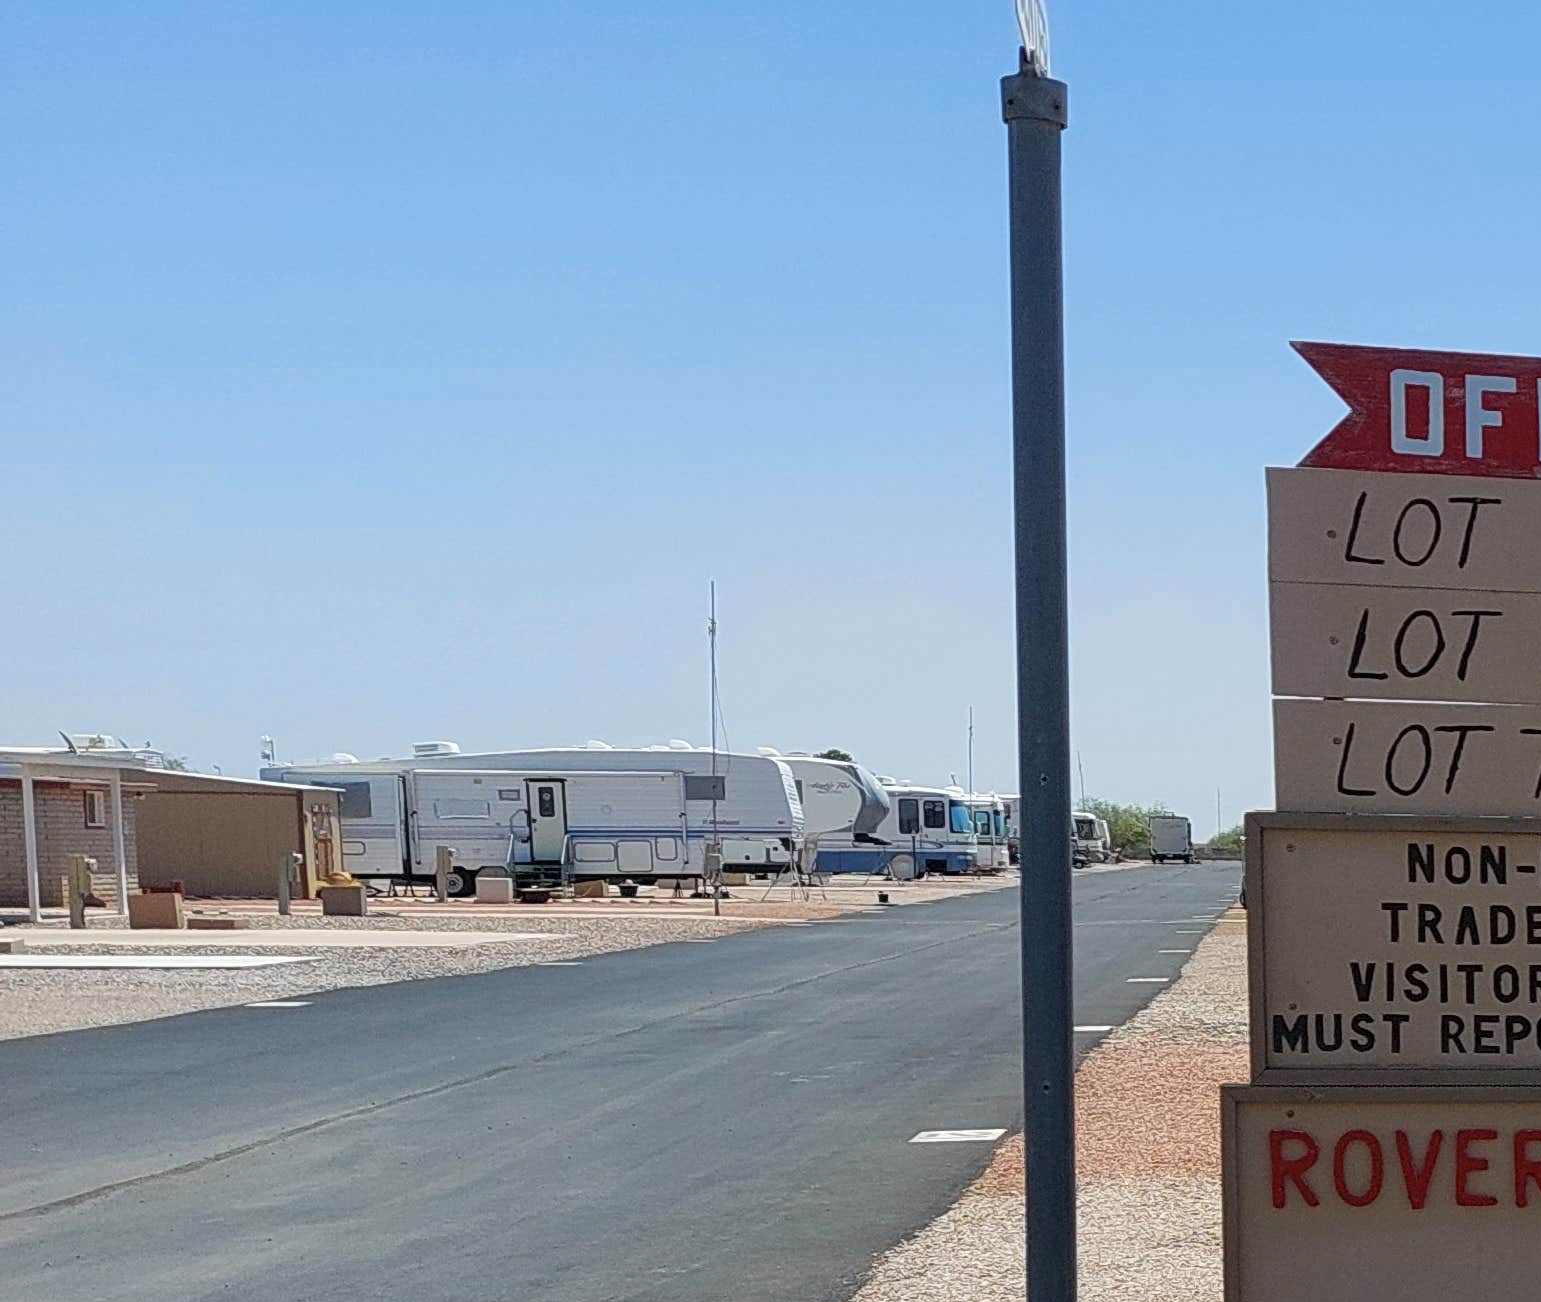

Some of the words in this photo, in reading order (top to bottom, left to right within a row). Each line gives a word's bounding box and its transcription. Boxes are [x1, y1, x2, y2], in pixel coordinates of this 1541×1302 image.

[1344, 490, 1502, 569] LOT
[1347, 607, 1504, 682] LOT
[1337, 722, 1496, 797] LOT
[1268, 1012, 1411, 1059] MUST
